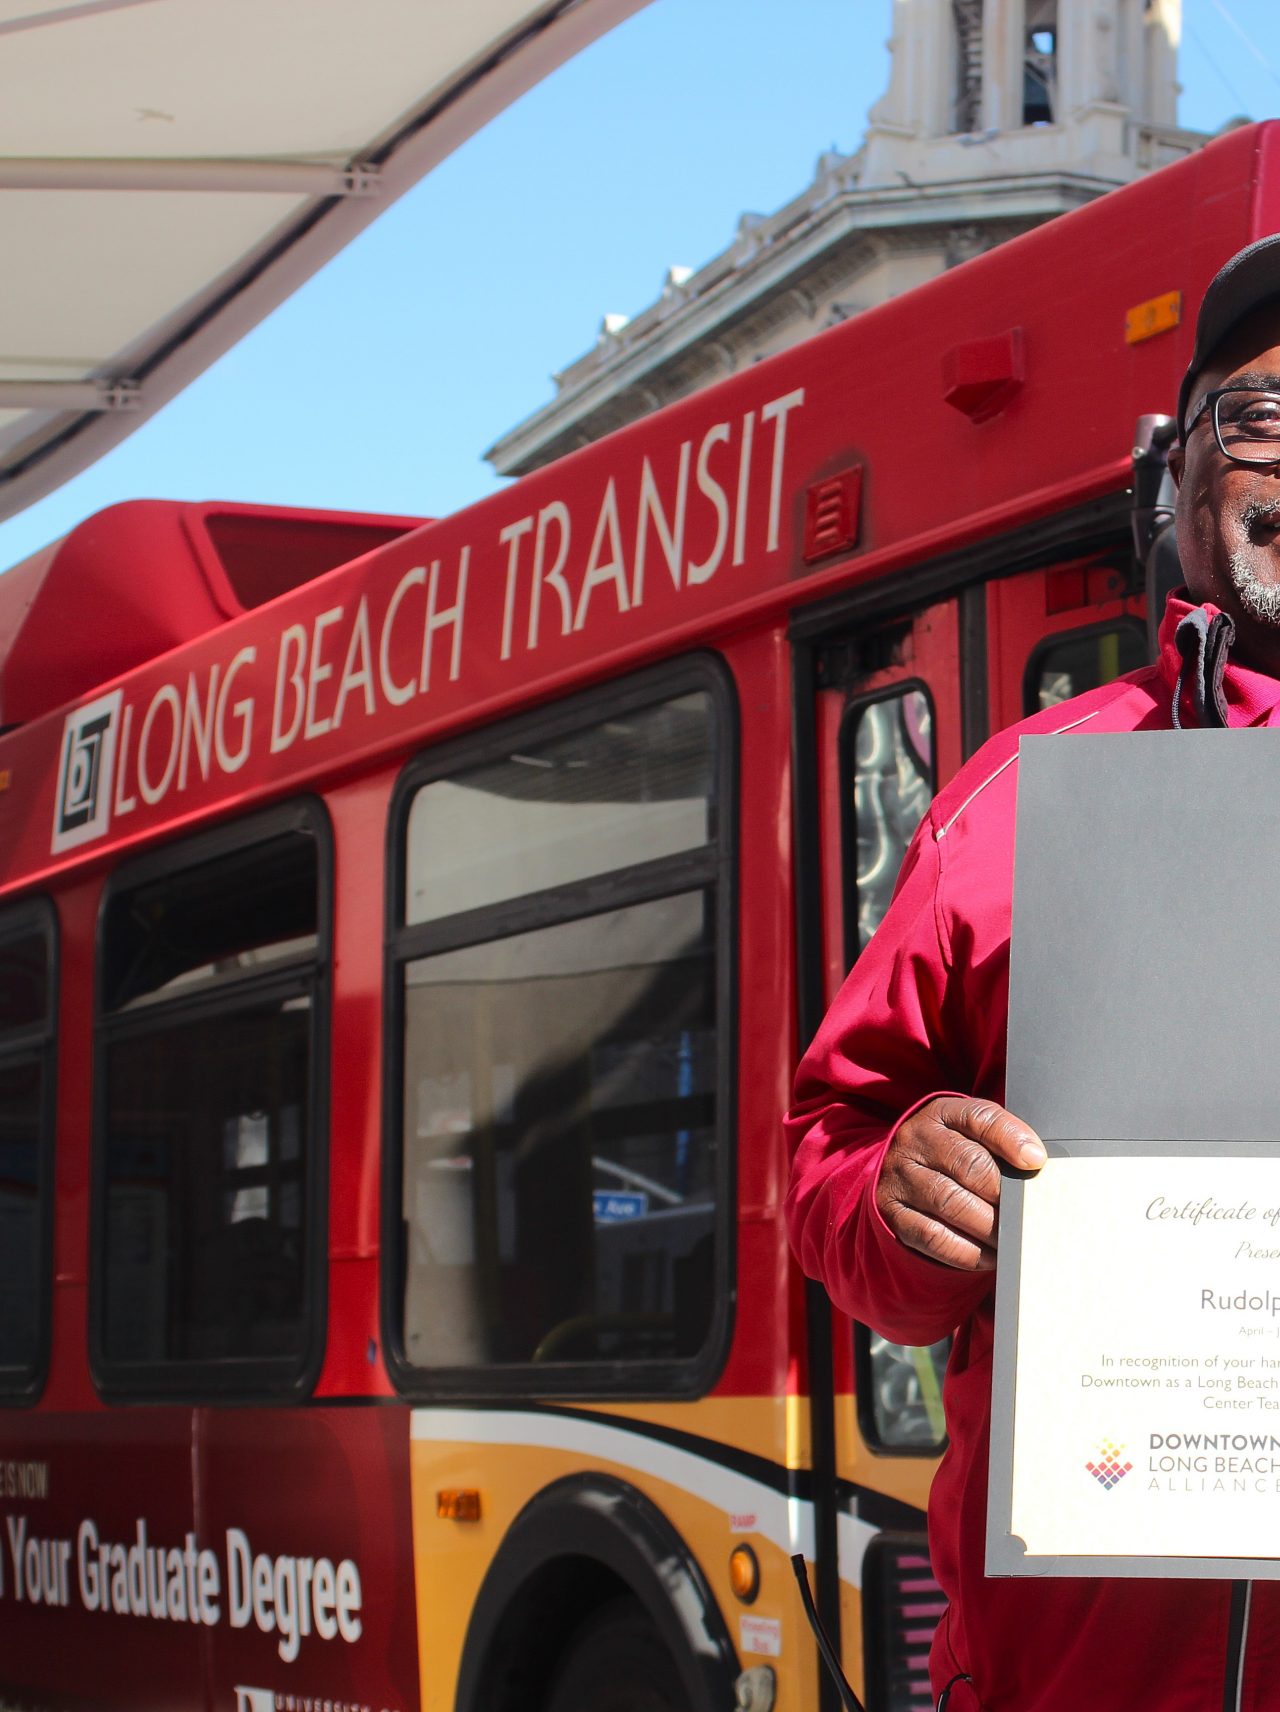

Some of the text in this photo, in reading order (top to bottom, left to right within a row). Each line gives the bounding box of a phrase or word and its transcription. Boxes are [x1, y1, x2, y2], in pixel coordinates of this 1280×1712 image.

[114, 388, 805, 817] LONG BEACH TRANSIT
[1146, 1197, 1257, 1225] Certificate
[1239, 1326, 1264, 1338] April
[1101, 1354, 1114, 1367] In
[1119, 1354, 1199, 1373] recognition
[1204, 1355, 1218, 1368] of
[1223, 1358, 1256, 1374] your
[1081, 1374, 1161, 1388] Downtown
[1166, 1377, 1180, 1388] as
[1185, 1377, 1192, 1388] a
[1198, 1375, 1232, 1392] Long
[1238, 1375, 1279, 1389] Beach
[1203, 1397, 1253, 1410] Center
[1149, 1456, 1208, 1474] LONG
[18, 1462, 48, 1499] NOW
[6, 1514, 71, 1607] Your
[77, 1517, 221, 1627] Graduate
[226, 1527, 363, 1663] Degree
